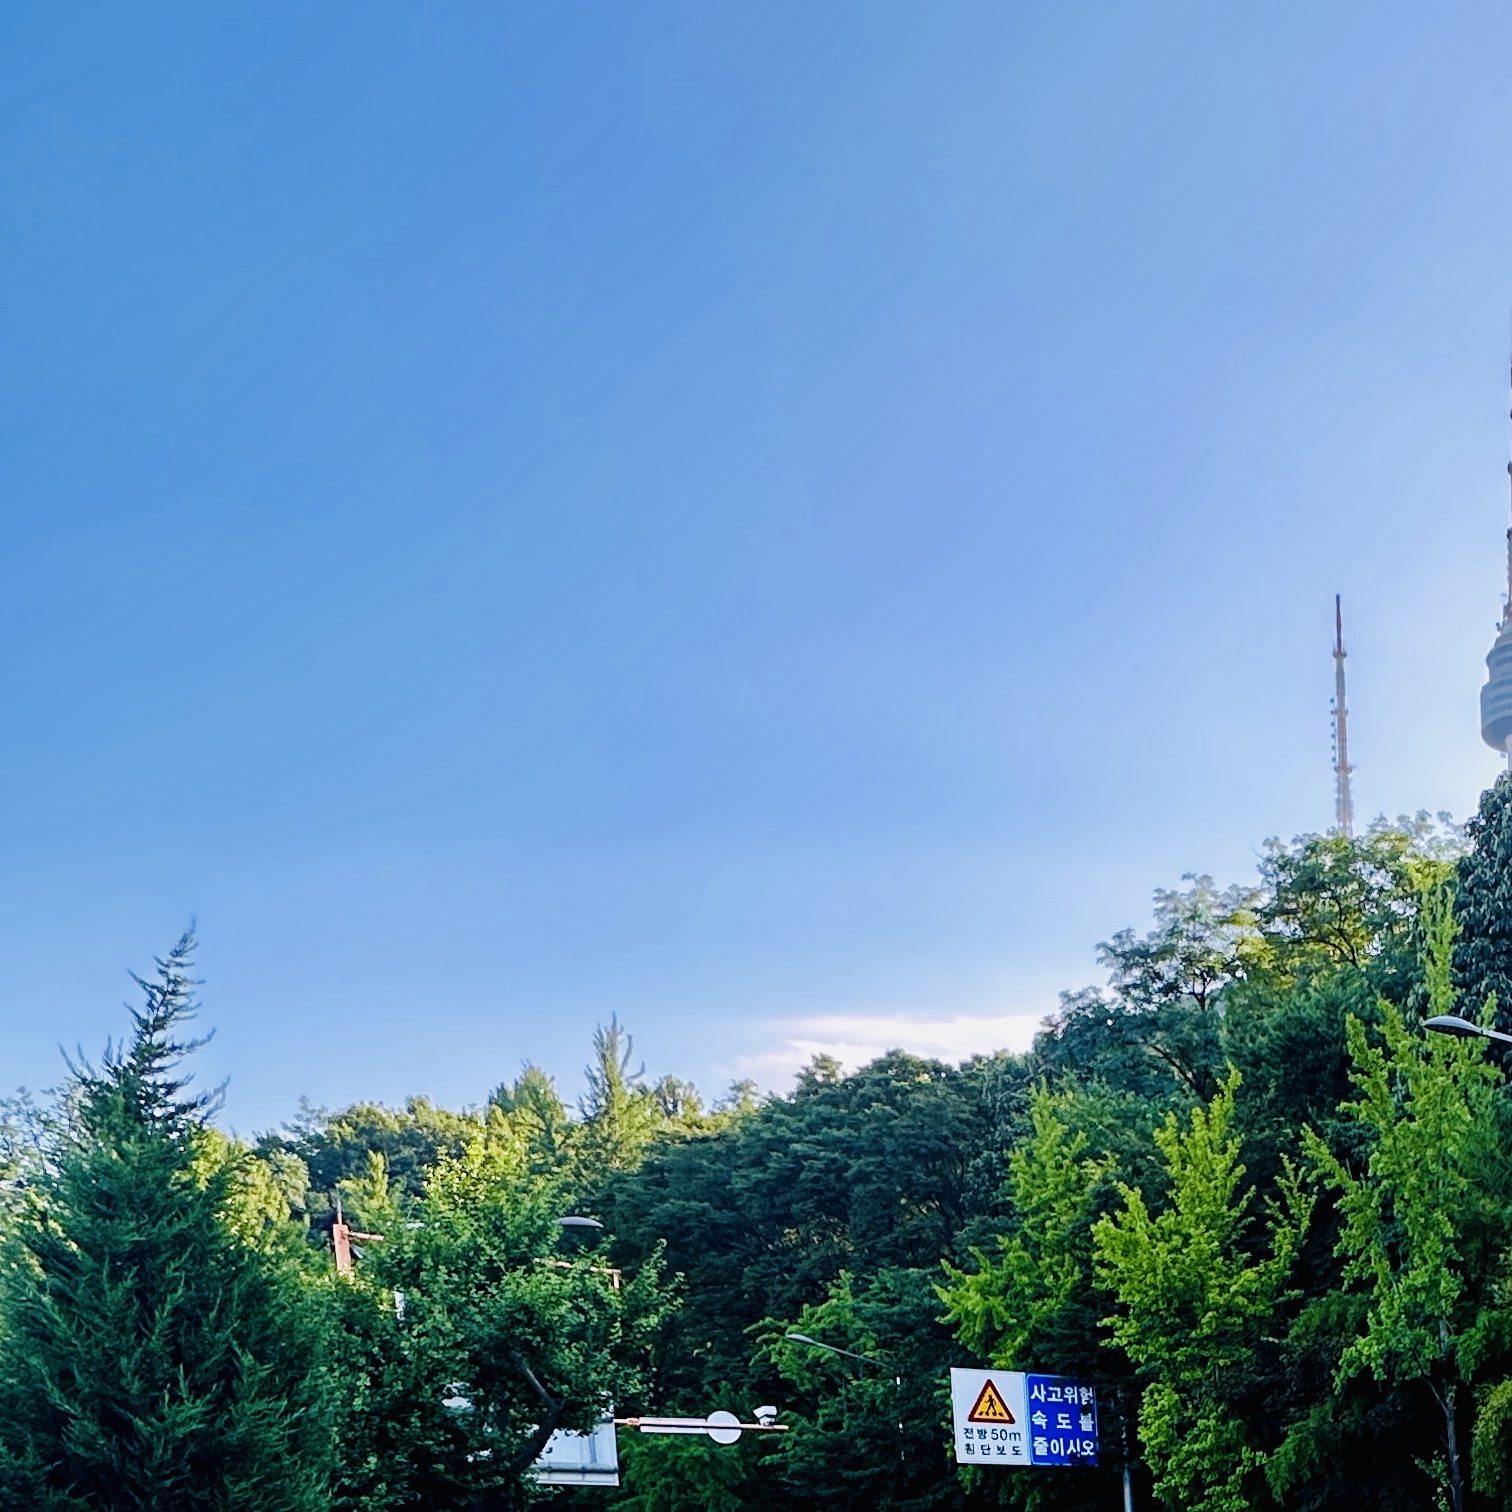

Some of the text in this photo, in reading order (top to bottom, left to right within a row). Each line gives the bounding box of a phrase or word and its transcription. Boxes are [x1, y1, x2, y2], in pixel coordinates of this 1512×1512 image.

[1030, 1383, 1094, 1406] 사고위험
[990, 1428, 1022, 1442] 50m
[1033, 1436, 1096, 1458] 줄이시오
